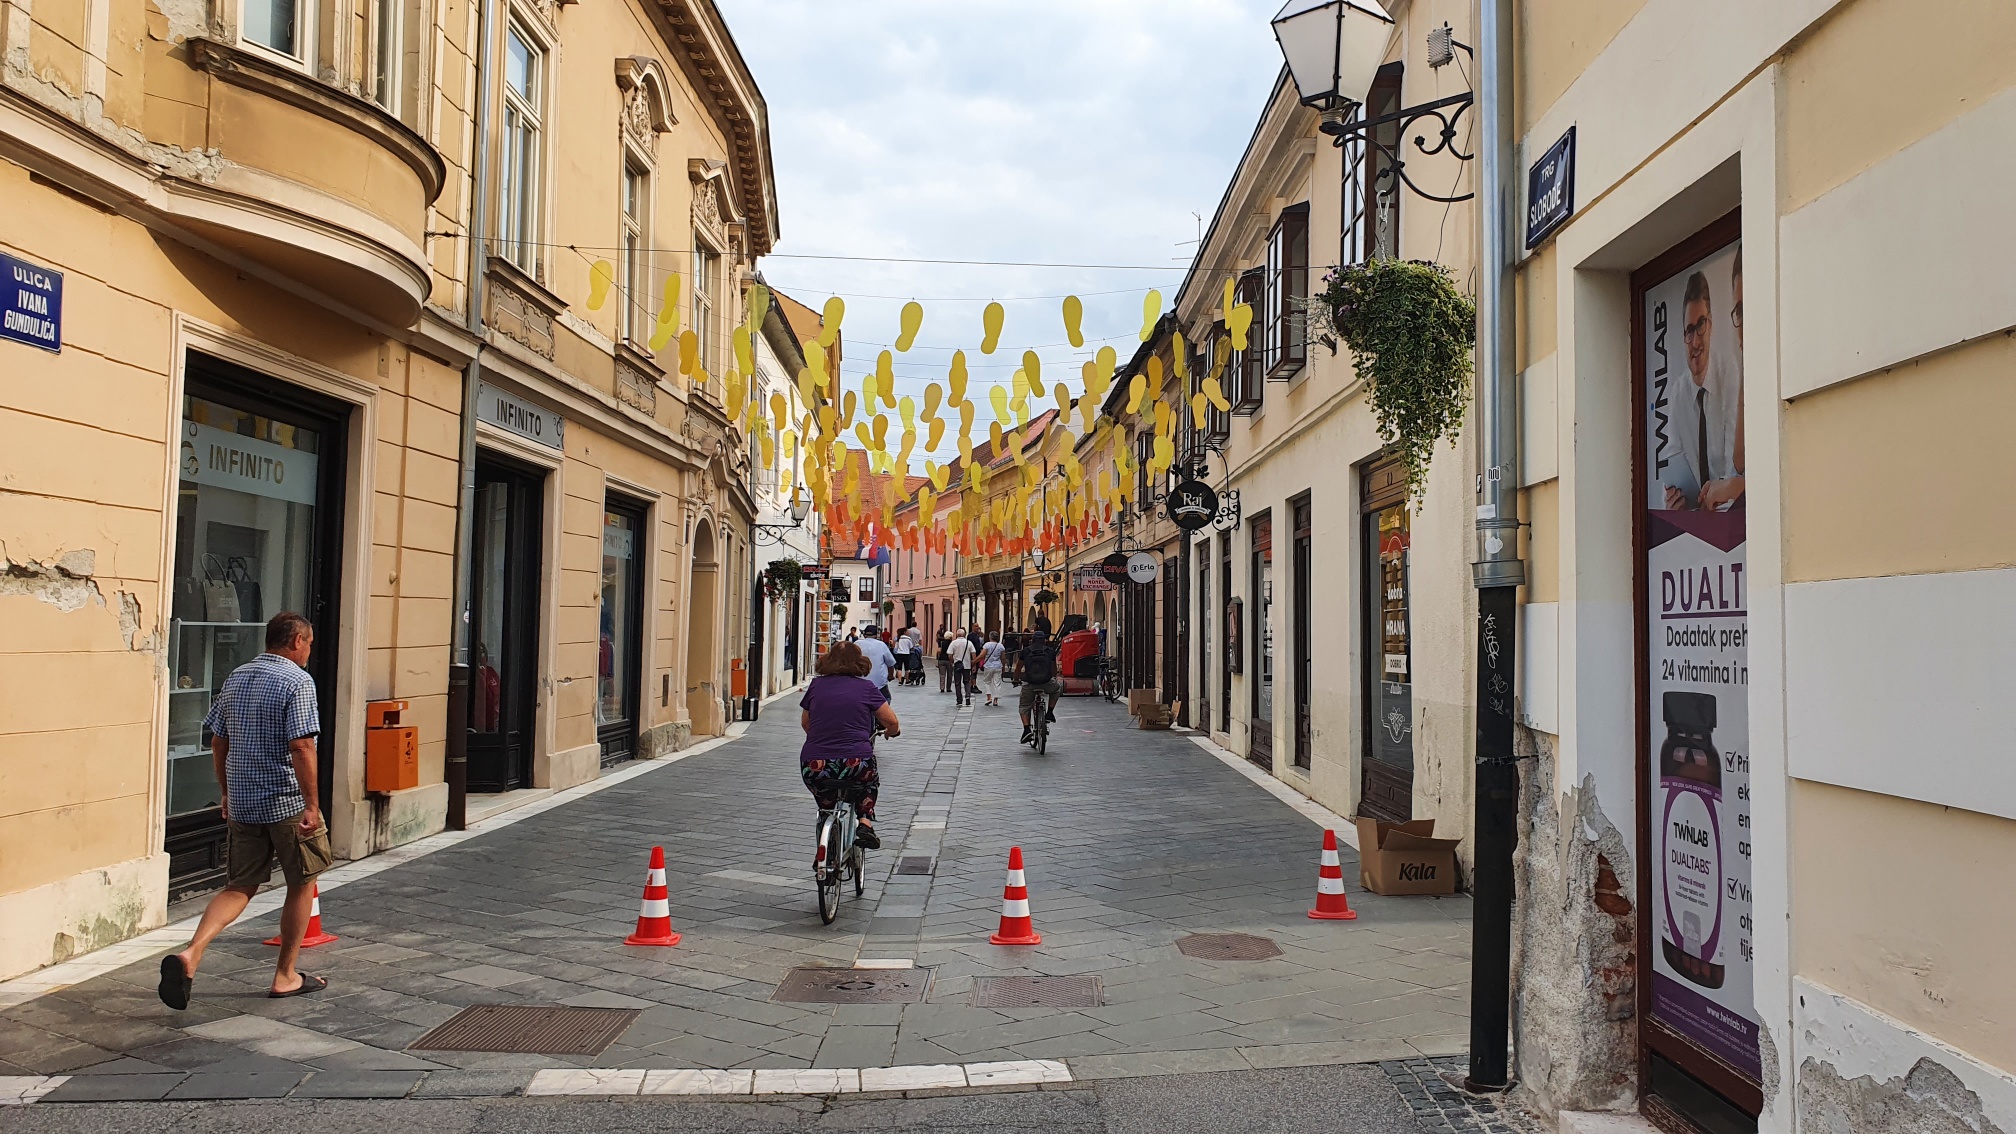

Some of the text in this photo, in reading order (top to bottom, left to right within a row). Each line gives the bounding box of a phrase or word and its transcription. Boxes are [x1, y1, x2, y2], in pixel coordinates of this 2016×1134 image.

[1541, 160, 1555, 183] TRG
[1530, 181, 1562, 228] SLOBODE
[13, 265, 52, 292] ULICA
[18, 289, 48, 316] IVANA
[4, 309, 55, 342] GUNDULIĆA
[497, 397, 542, 437] INFINITO
[209, 444, 284, 485] INFINITO
[1183, 492, 1203, 508] Raj
[1666, 623, 1717, 648] Dodatak
[1662, 658, 1675, 681] 24
[1678, 658, 1730, 685] vitamina
[1733, 660, 1737, 685] i
[1398, 862, 1437, 882] Kala
[1671, 849, 1710, 876] DUALTABS
